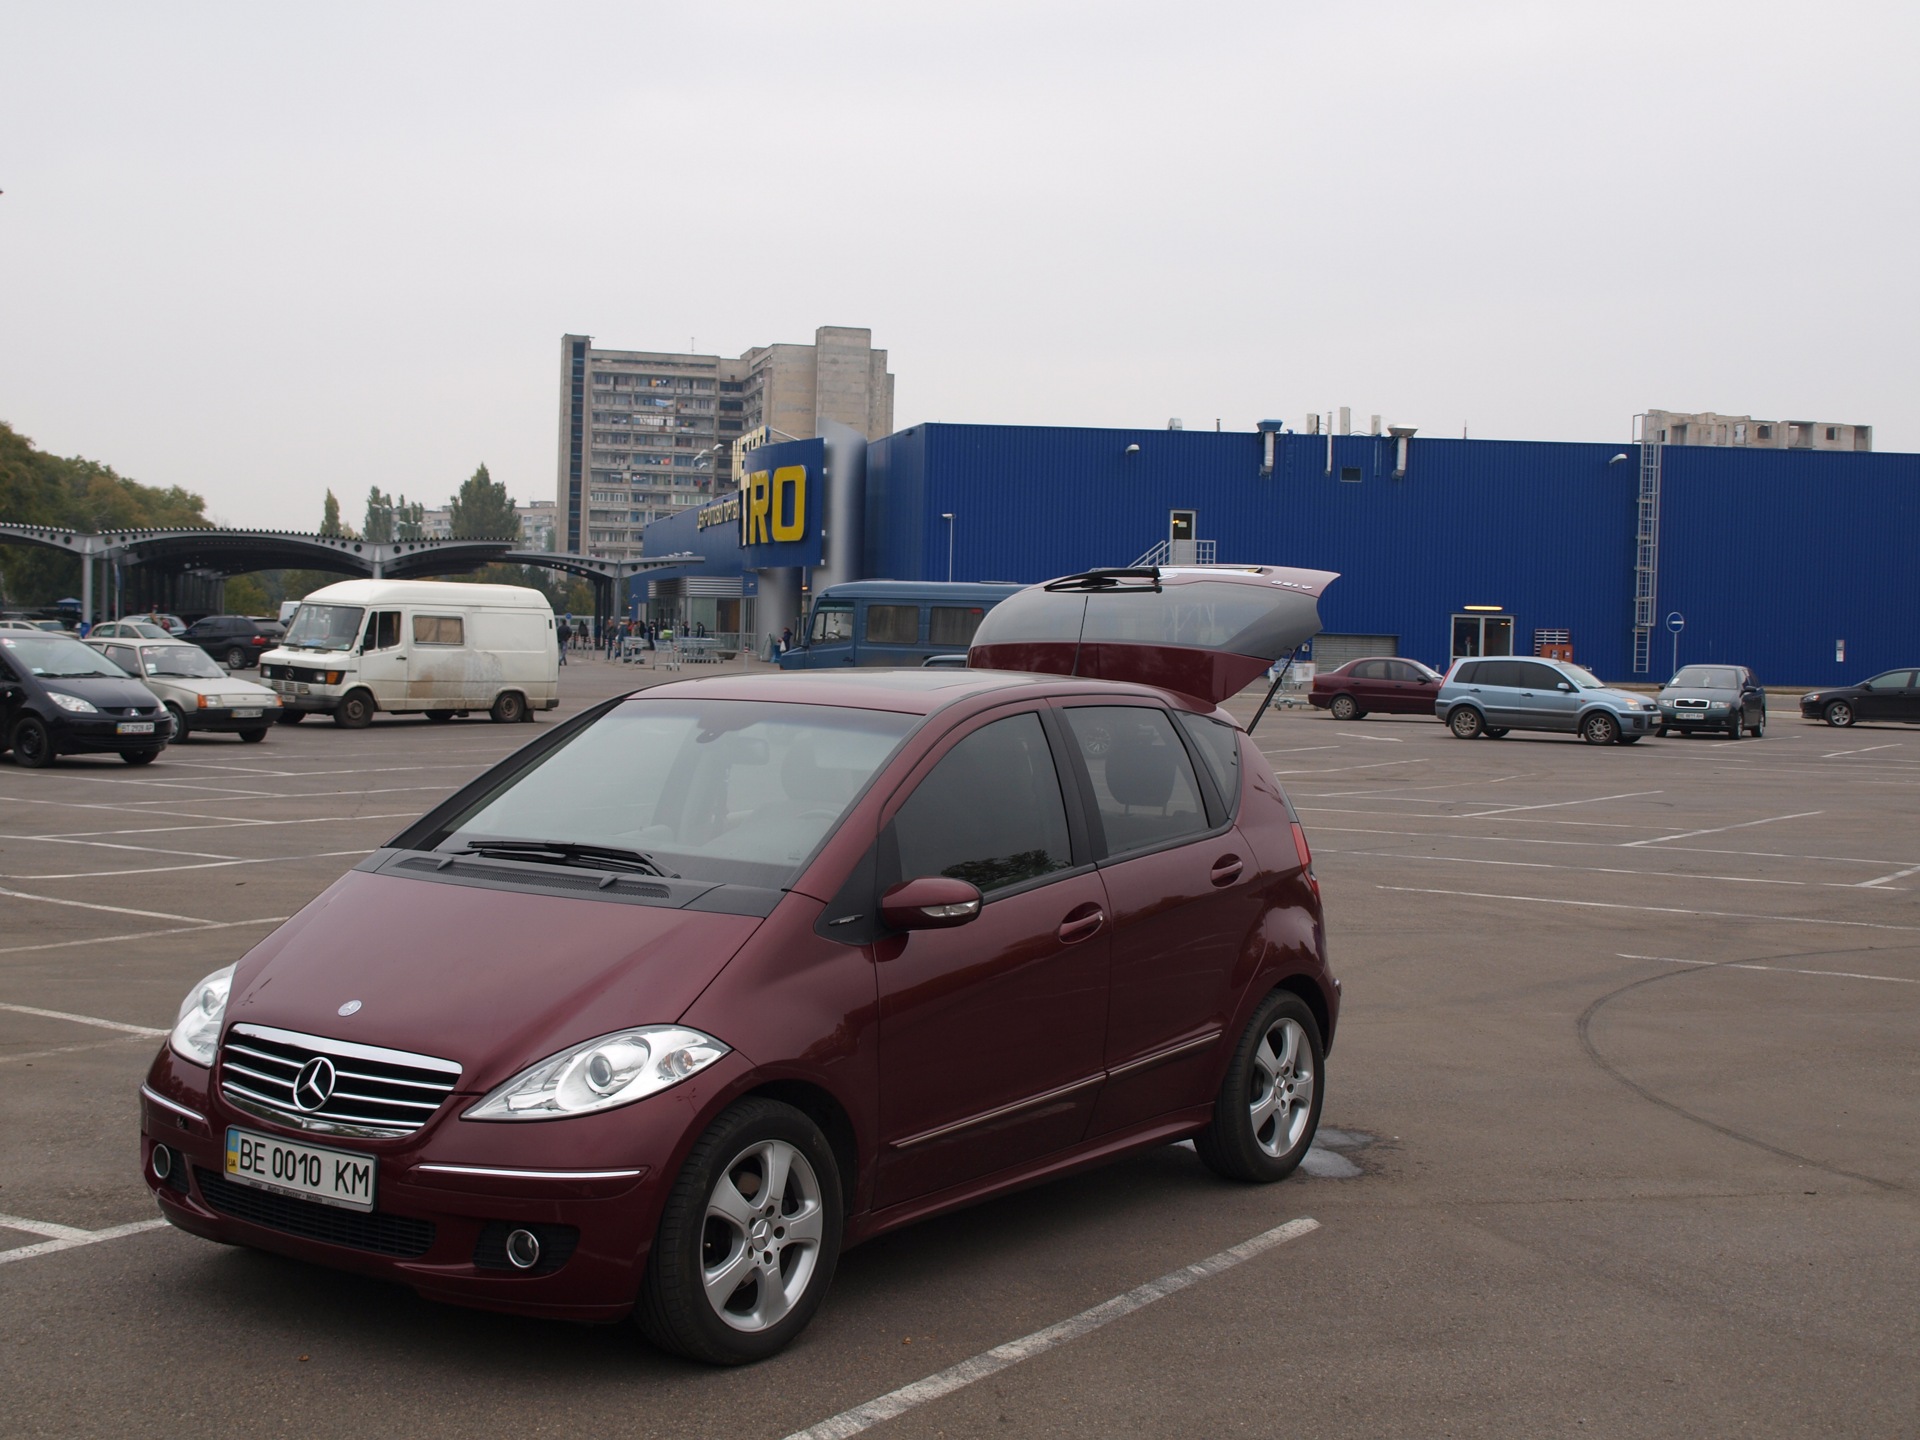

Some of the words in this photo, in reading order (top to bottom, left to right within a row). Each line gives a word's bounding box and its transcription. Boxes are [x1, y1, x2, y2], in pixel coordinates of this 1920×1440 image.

[740, 465, 806, 546] TRO
[240, 1138, 266, 1175] BE
[272, 1147, 322, 1187] 0010
[335, 1159, 370, 1198] KM
